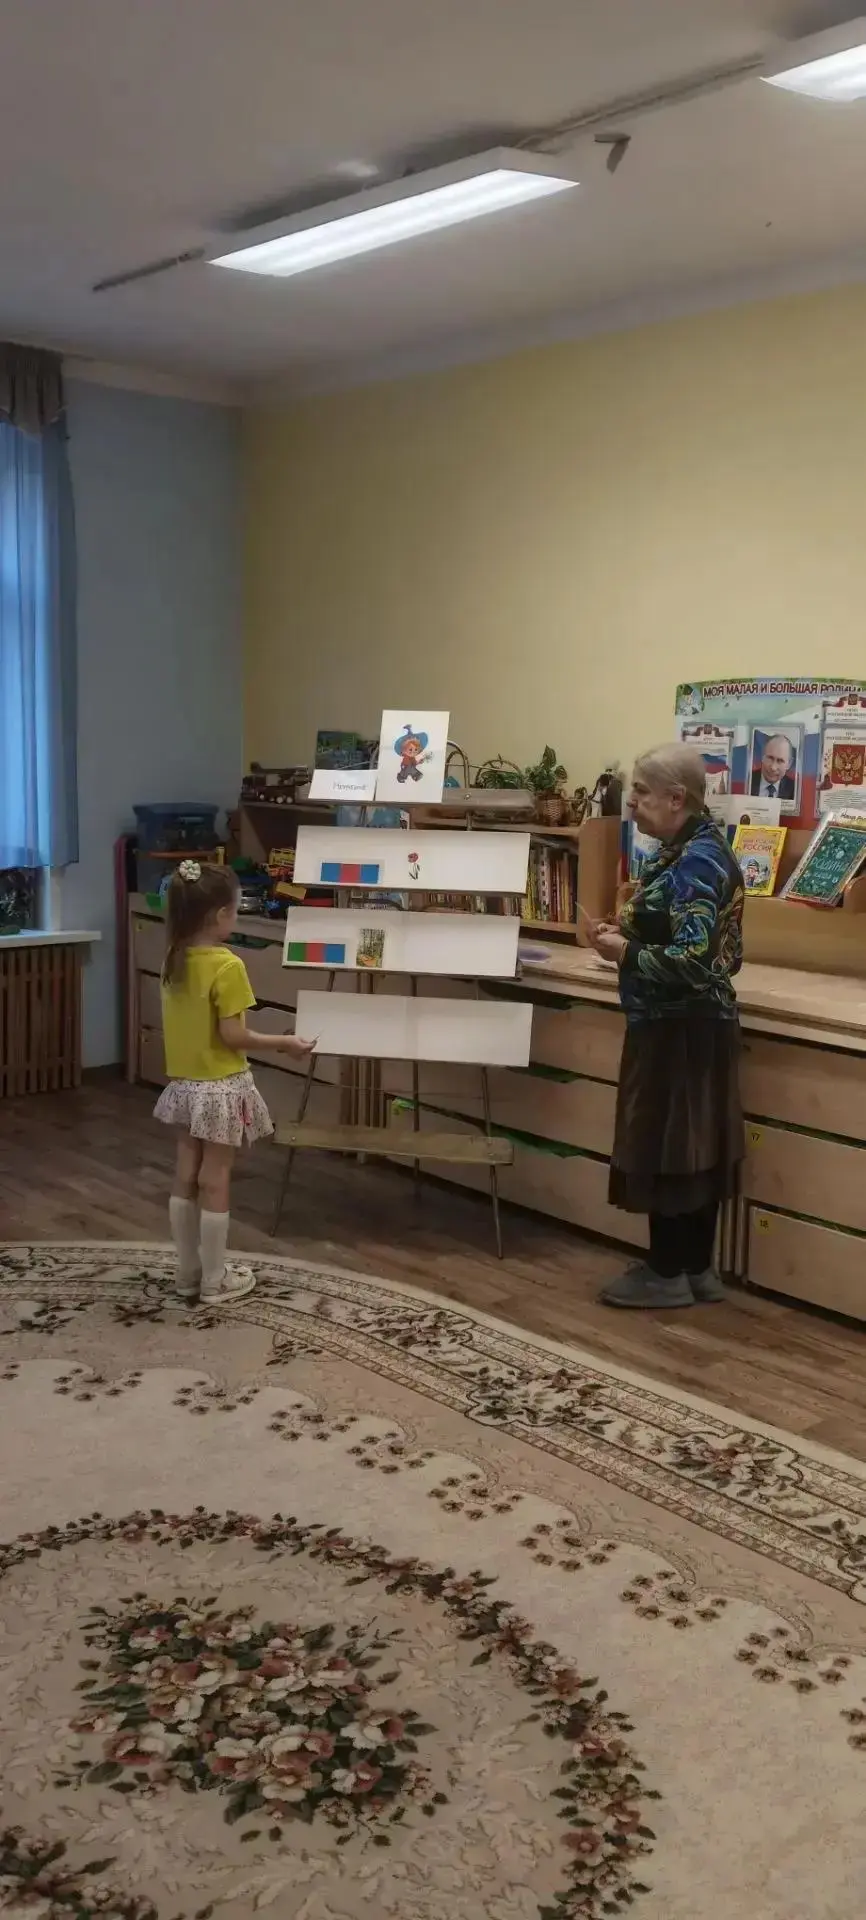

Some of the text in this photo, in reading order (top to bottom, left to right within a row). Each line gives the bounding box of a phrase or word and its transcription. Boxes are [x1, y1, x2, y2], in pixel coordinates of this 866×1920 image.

[703, 686, 725, 698] МОЯ
[726, 684, 759, 696] МАЛАЯ
[760, 683, 768, 694] И
[770, 682, 818, 694] БОЛЬШАЯ
